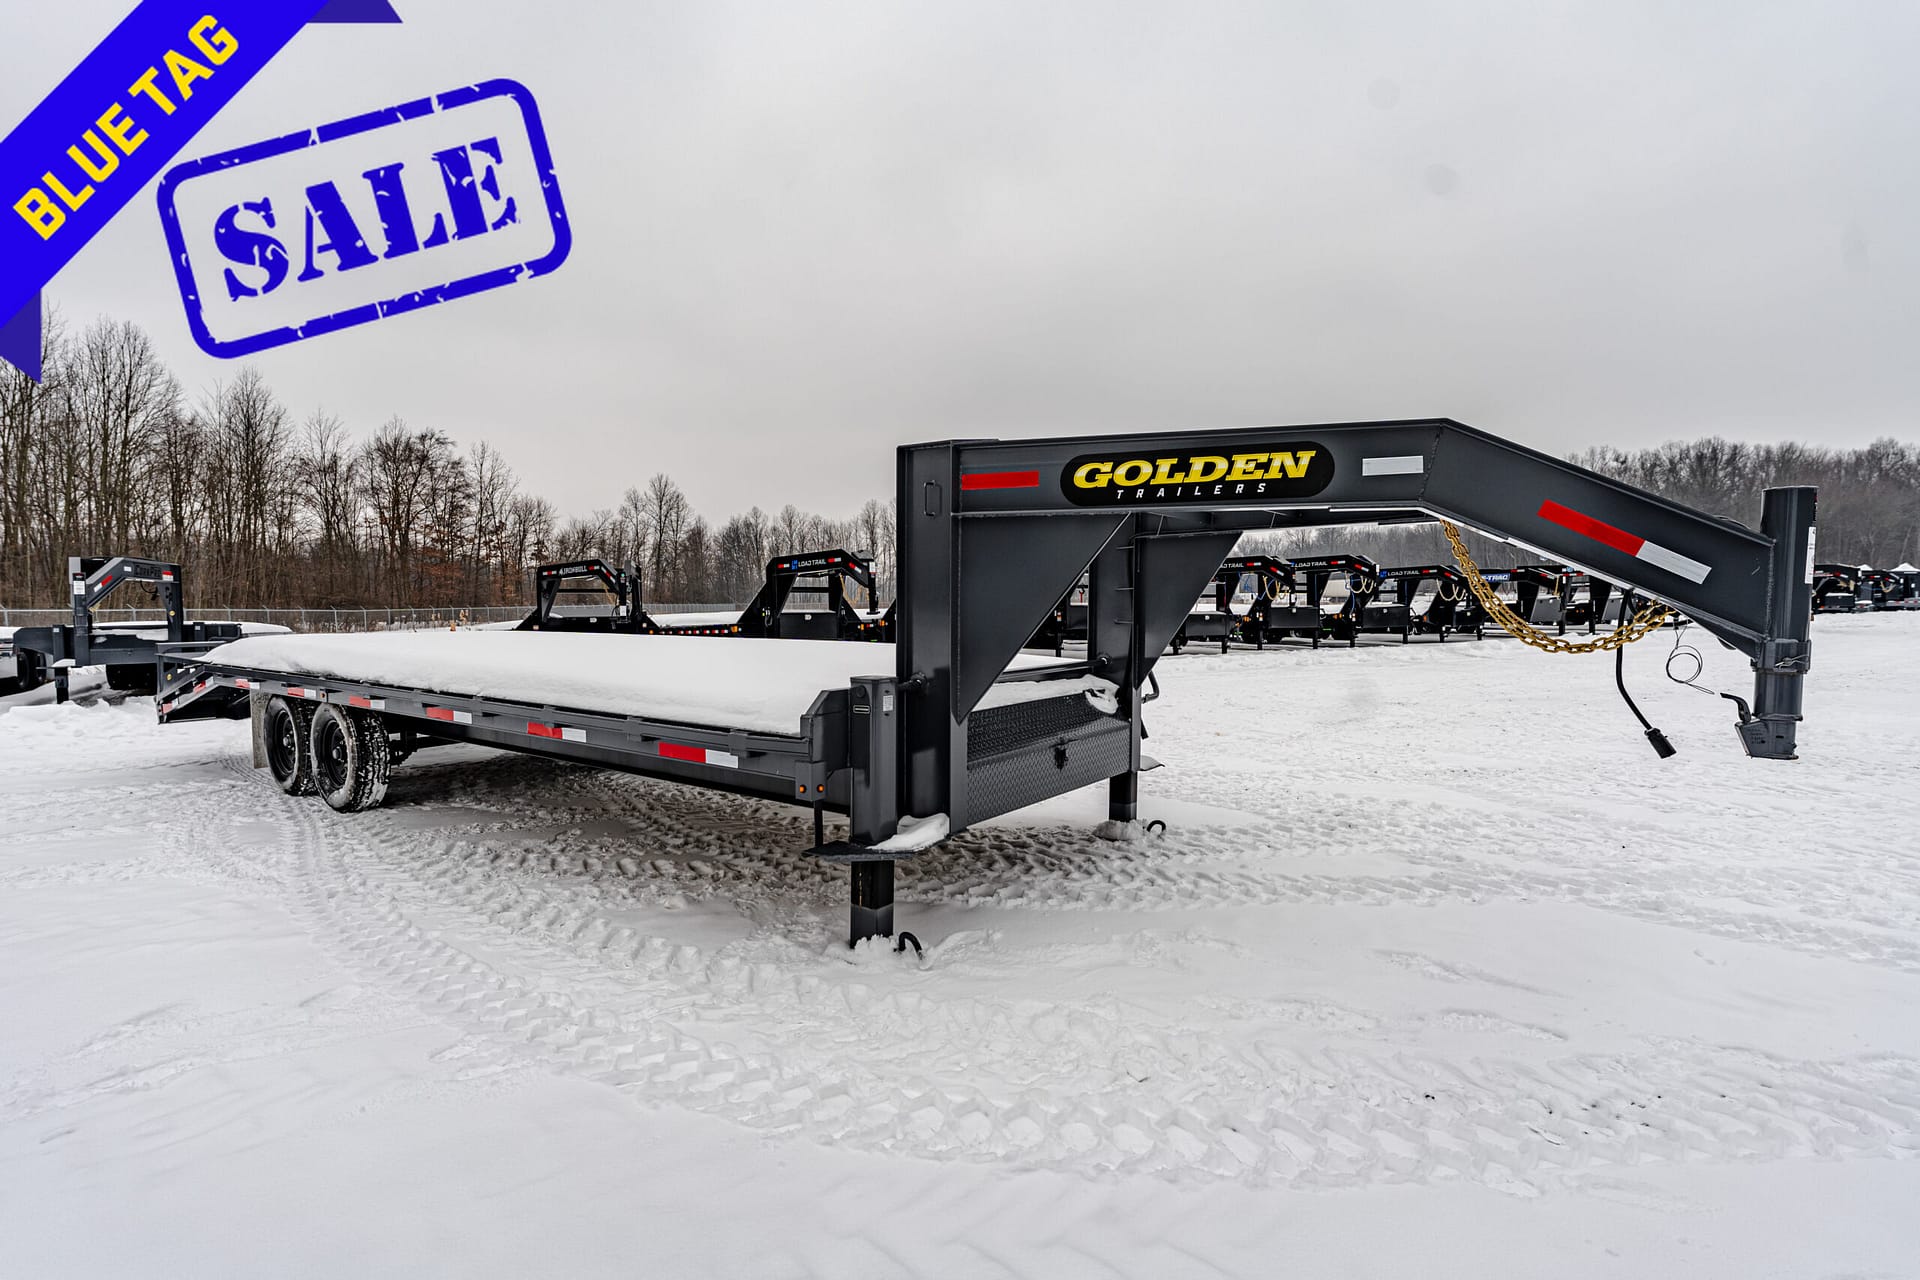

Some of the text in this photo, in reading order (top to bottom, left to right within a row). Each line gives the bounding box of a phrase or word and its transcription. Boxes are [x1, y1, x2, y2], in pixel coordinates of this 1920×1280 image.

[1073, 450, 1317, 489] GOLDEN
[1117, 482, 1266, 500] TRAILERS
[812, 558, 827, 566] TRAIL
